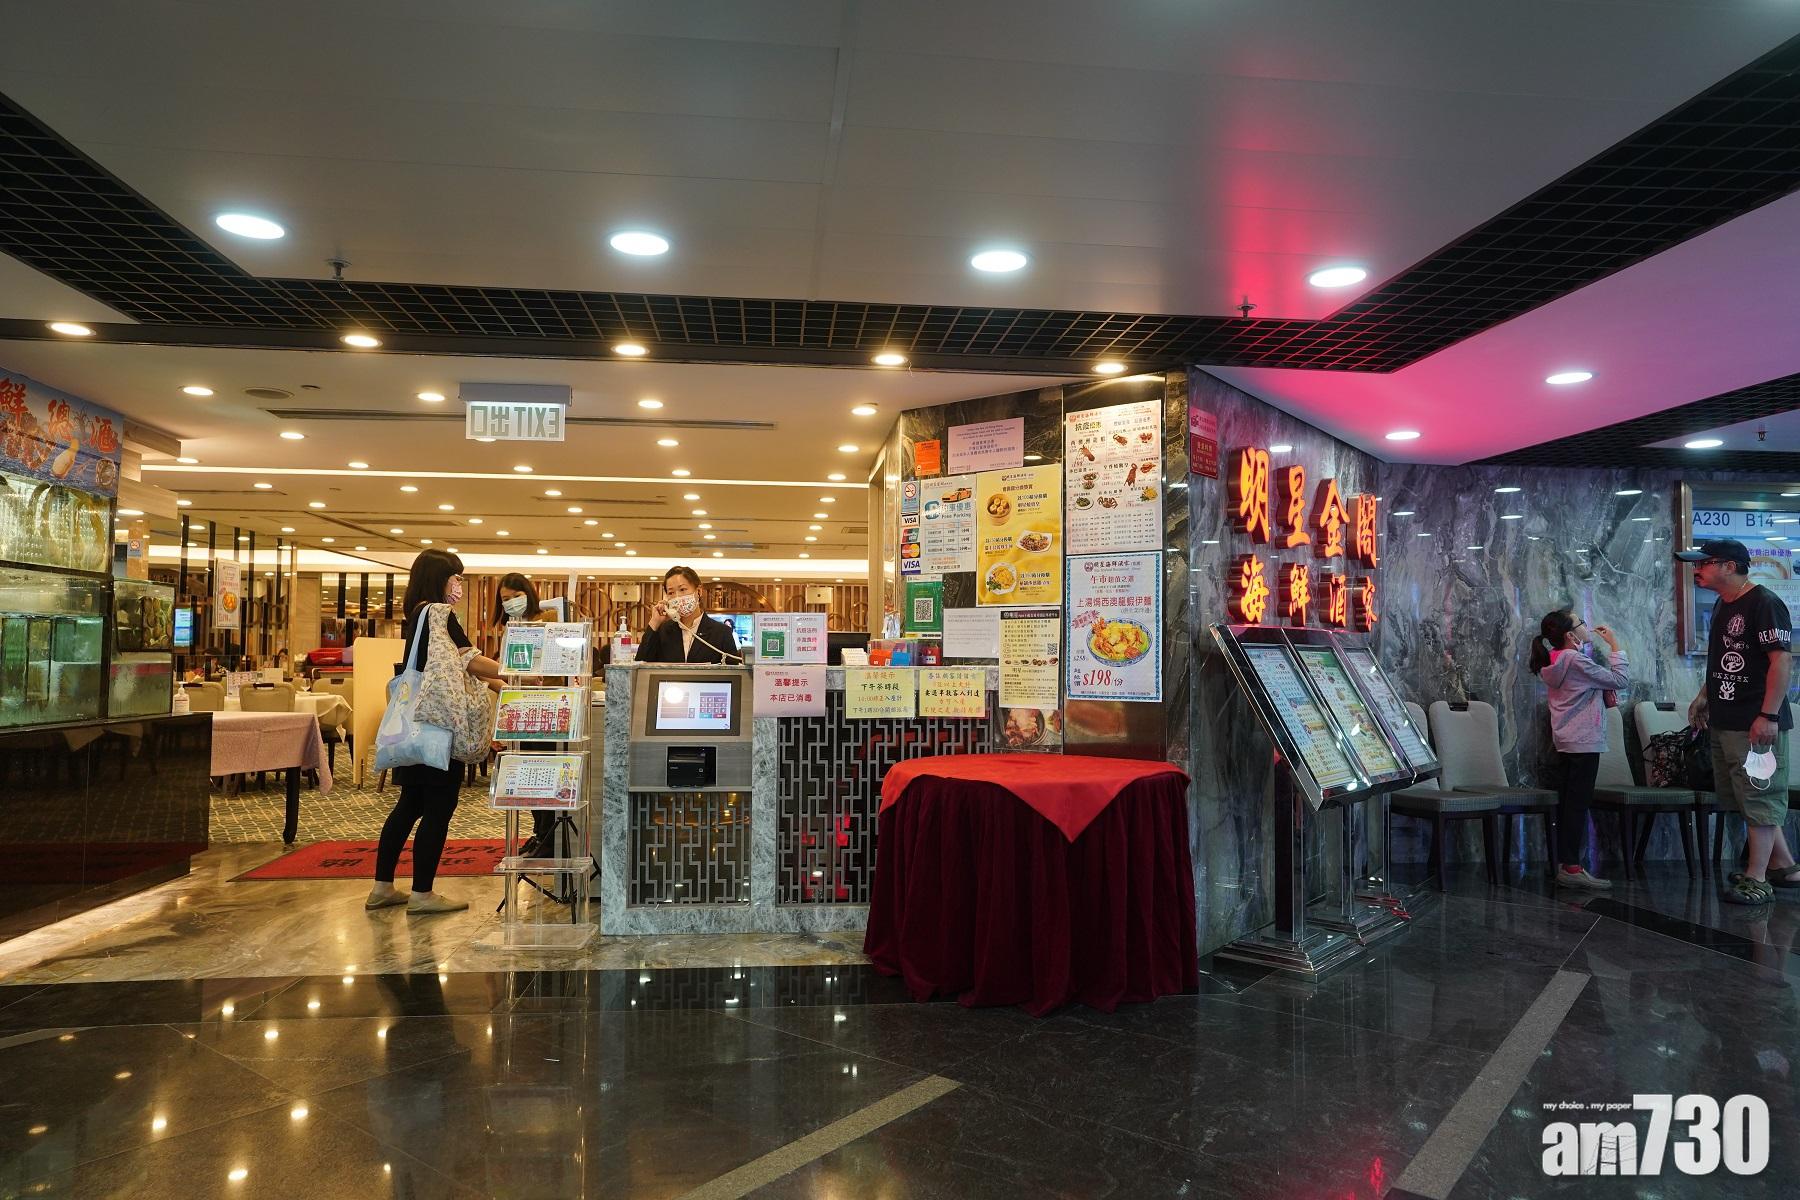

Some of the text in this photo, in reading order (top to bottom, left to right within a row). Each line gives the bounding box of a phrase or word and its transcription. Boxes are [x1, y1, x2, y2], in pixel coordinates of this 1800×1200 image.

[1238, 446, 1377, 569] 明星金閣
[1692, 512, 1730, 527] A230
[1745, 513, 1774, 527] B14
[903, 561, 920, 569] VISA
[1239, 553, 1378, 632] 海鮮酒家
[1725, 654, 1741, 662] FINCH
[860, 682, 900, 691] 下午茶時段
[769, 693, 812, 703] 本店已消毒
